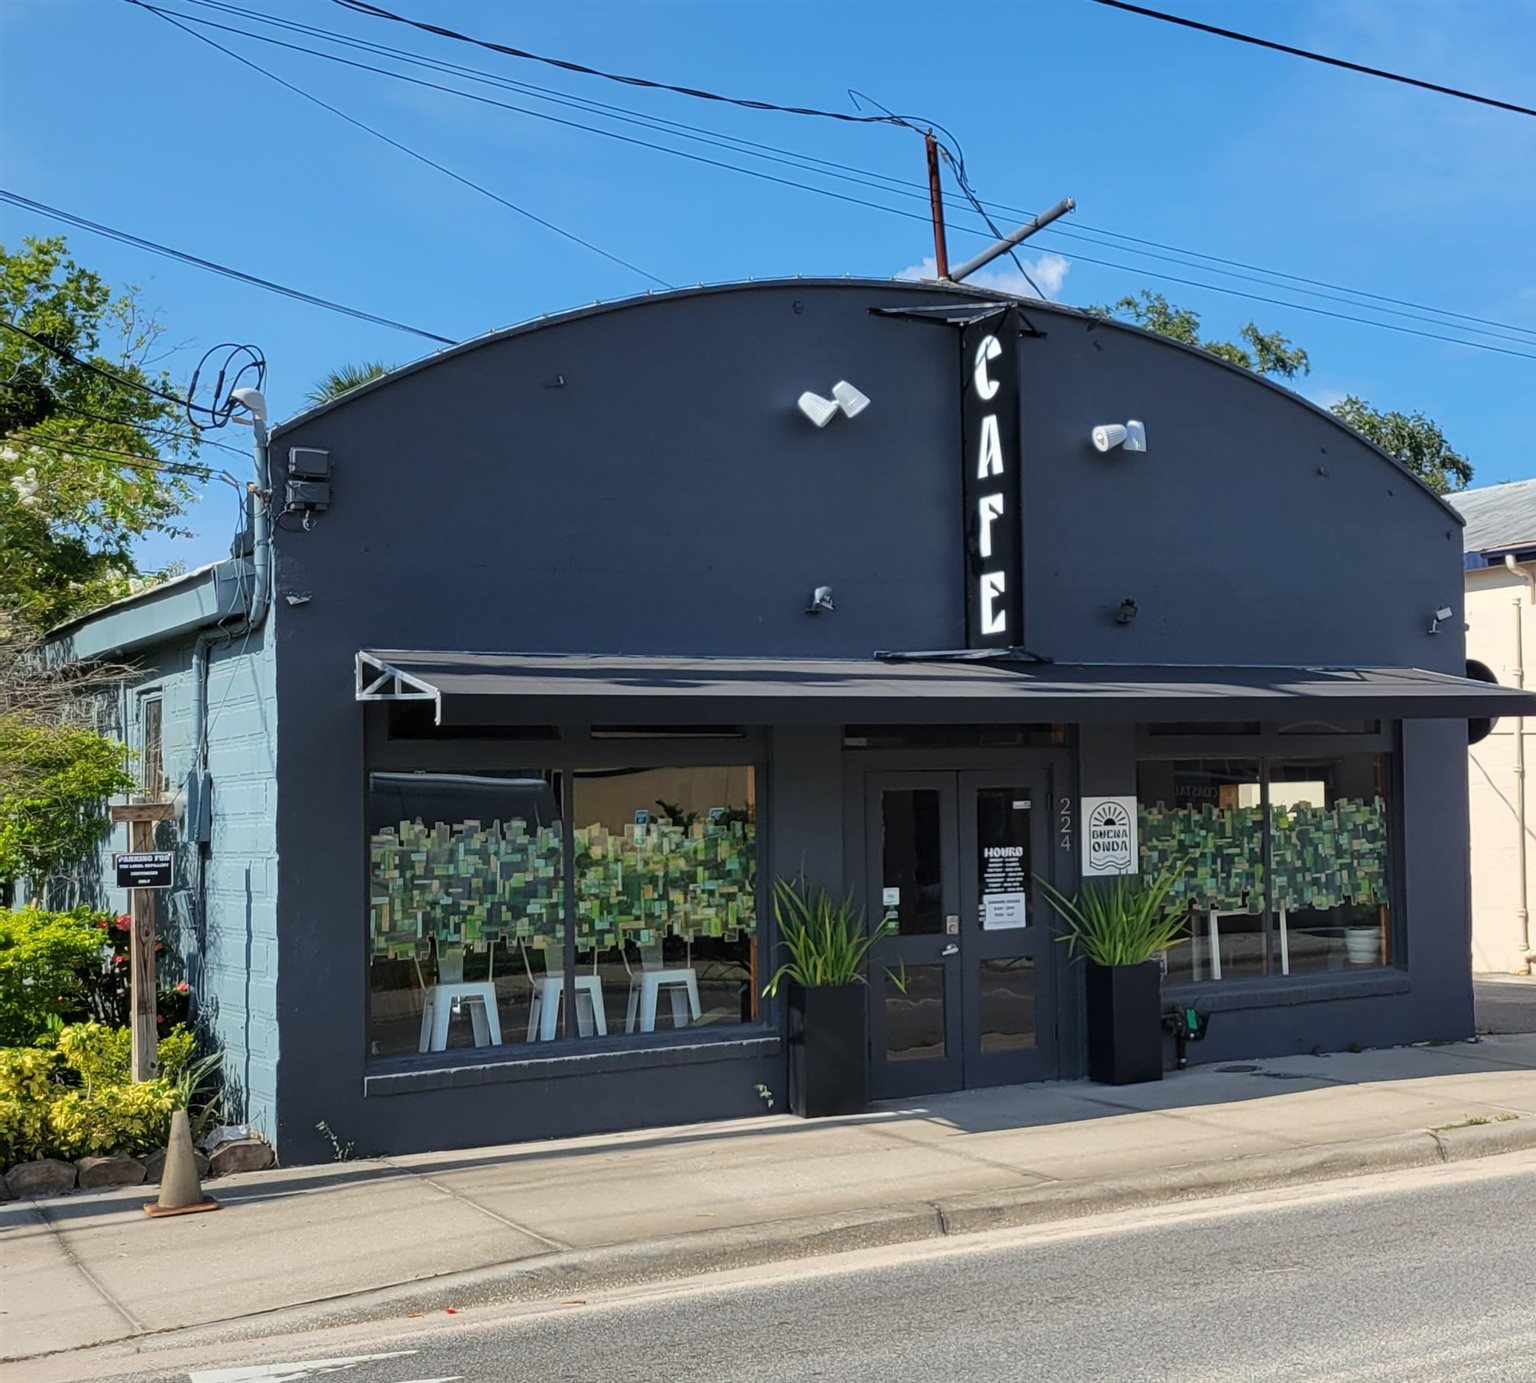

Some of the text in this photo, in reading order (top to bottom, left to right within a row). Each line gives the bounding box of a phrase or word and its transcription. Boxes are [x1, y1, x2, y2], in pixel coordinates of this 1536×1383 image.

[974, 334, 1006, 635] CAFE
[1060, 797, 1072, 852] 224
[1092, 829, 1128, 839] BUENA
[984, 846, 1023, 858] HOURS
[1092, 840, 1128, 853] ONDA
[118, 854, 170, 863] PARKING FOR
